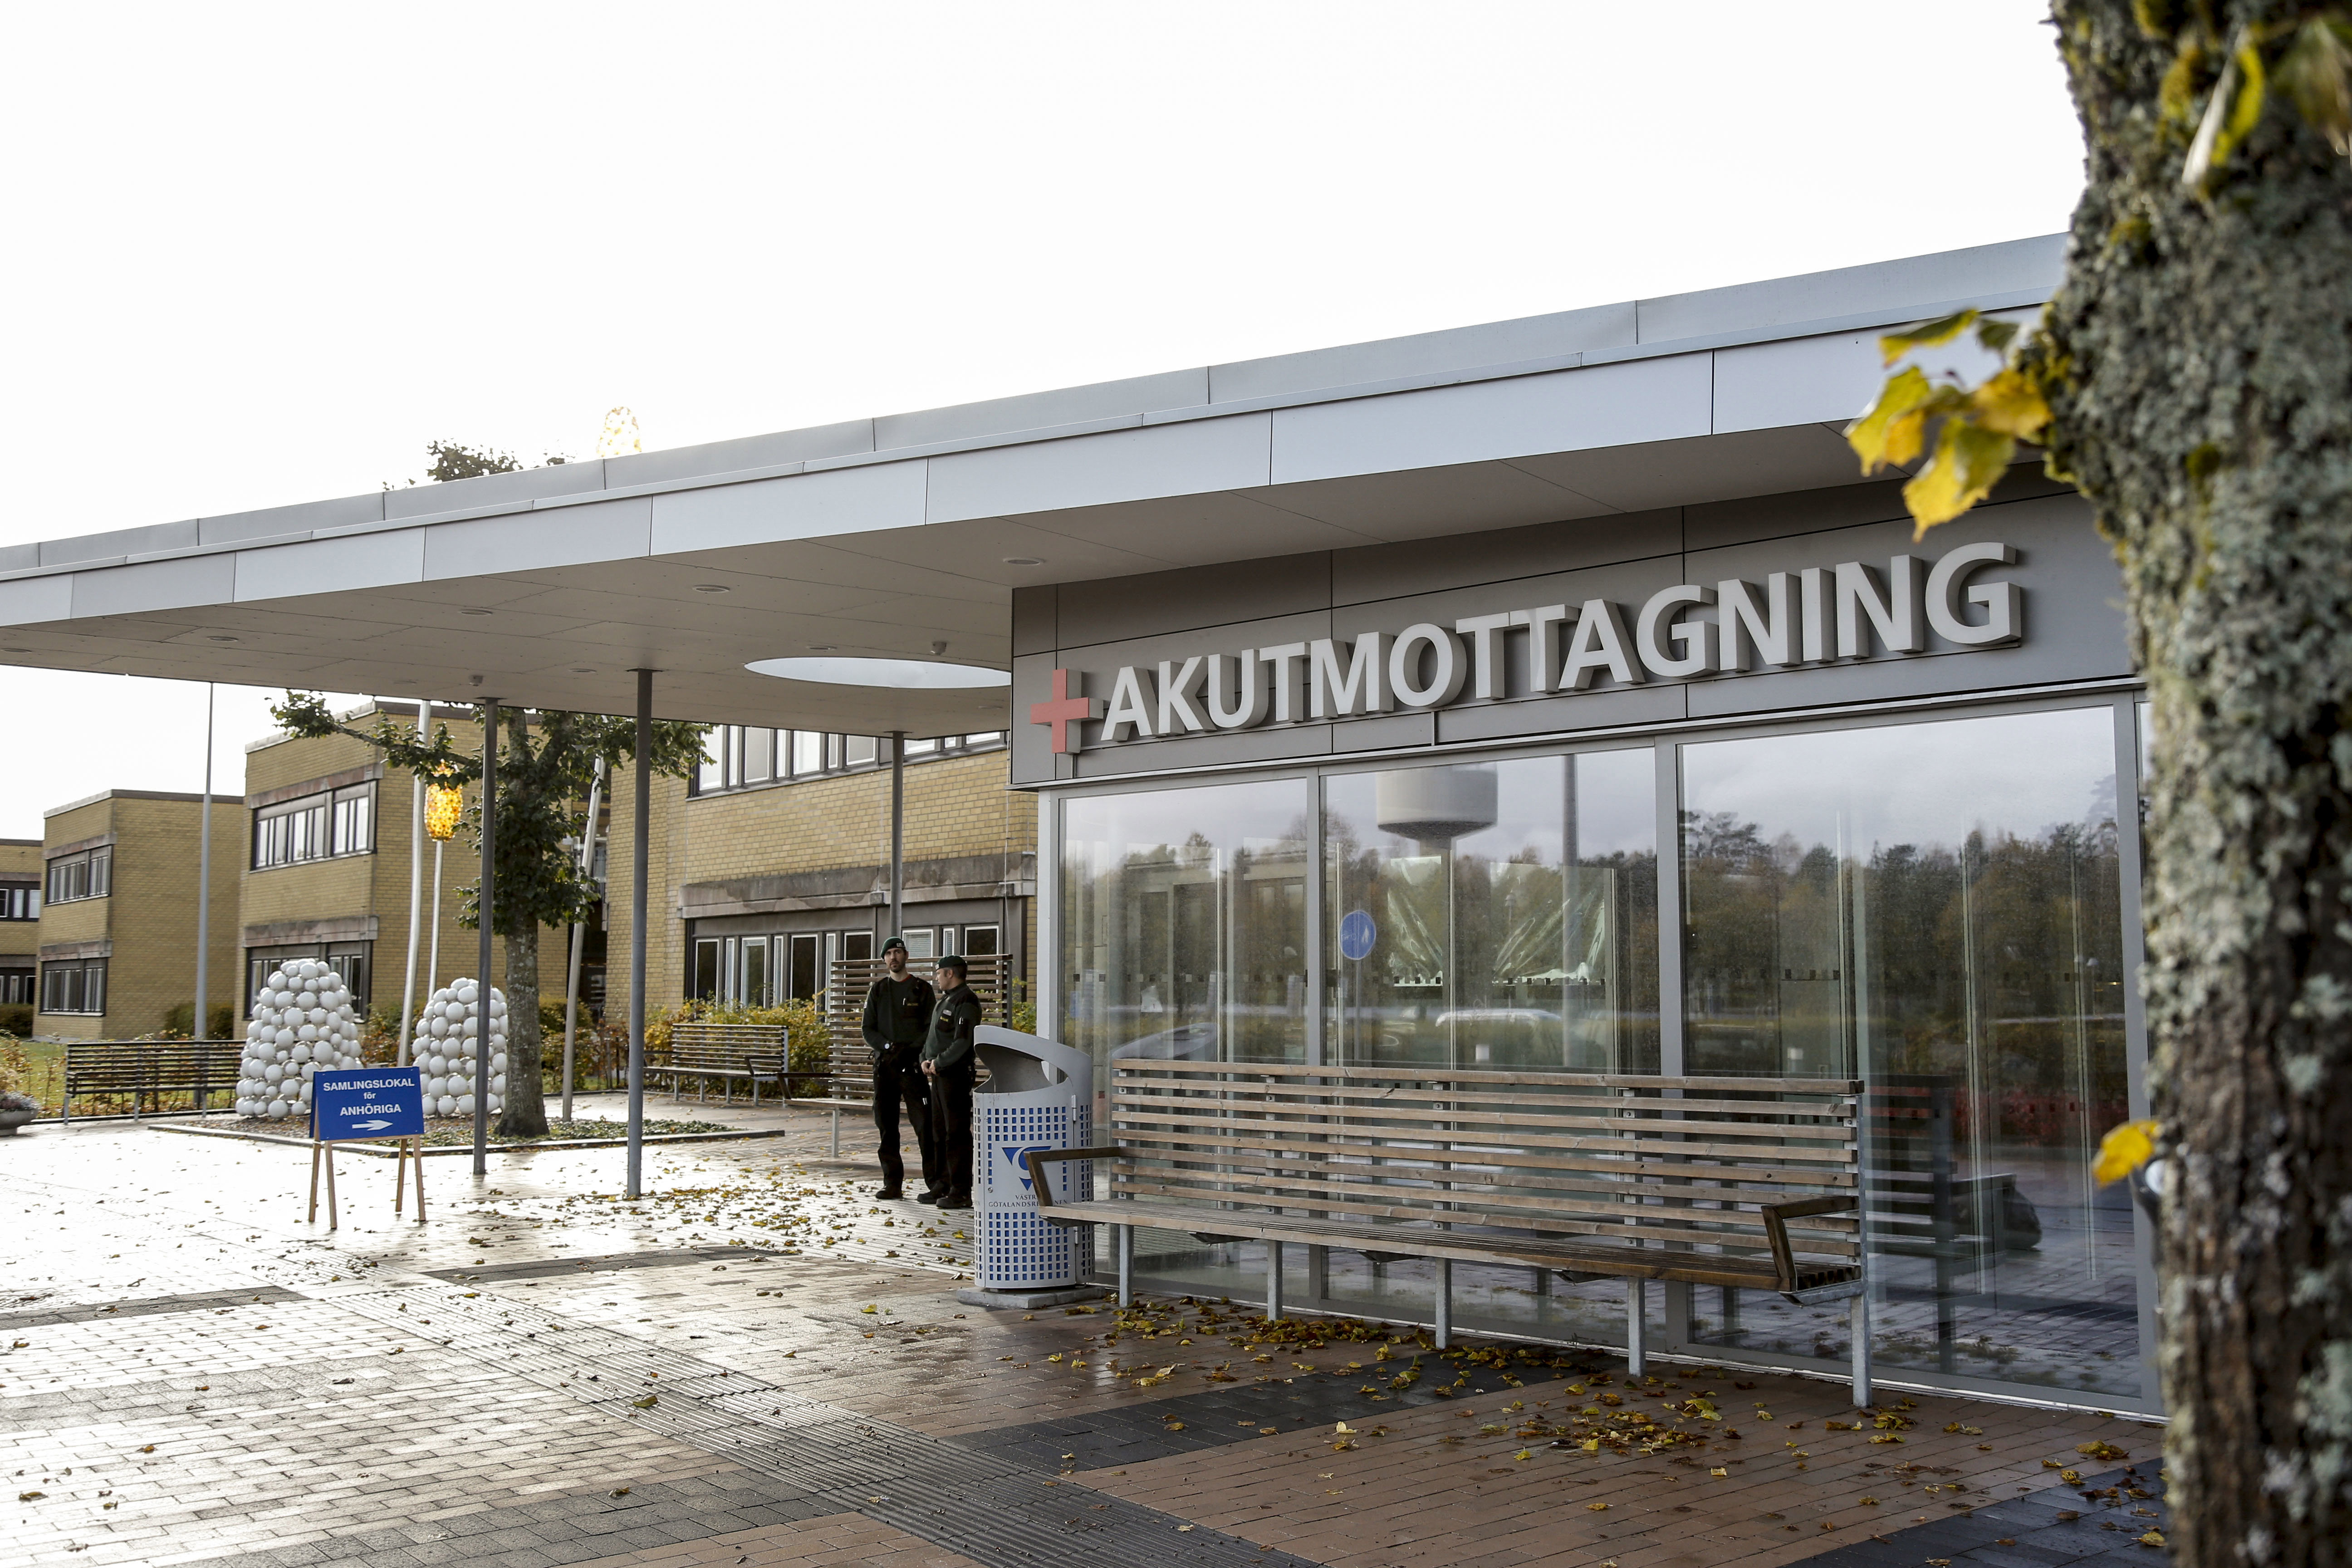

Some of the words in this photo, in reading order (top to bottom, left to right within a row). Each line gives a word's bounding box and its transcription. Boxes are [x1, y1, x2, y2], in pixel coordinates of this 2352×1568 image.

[1100, 542, 2022, 742] AKUTMOTTAGNING
[323, 1078, 415, 1091] SAMLINGSLOKAL
[340, 1103, 402, 1116] ANHÖRIGA
